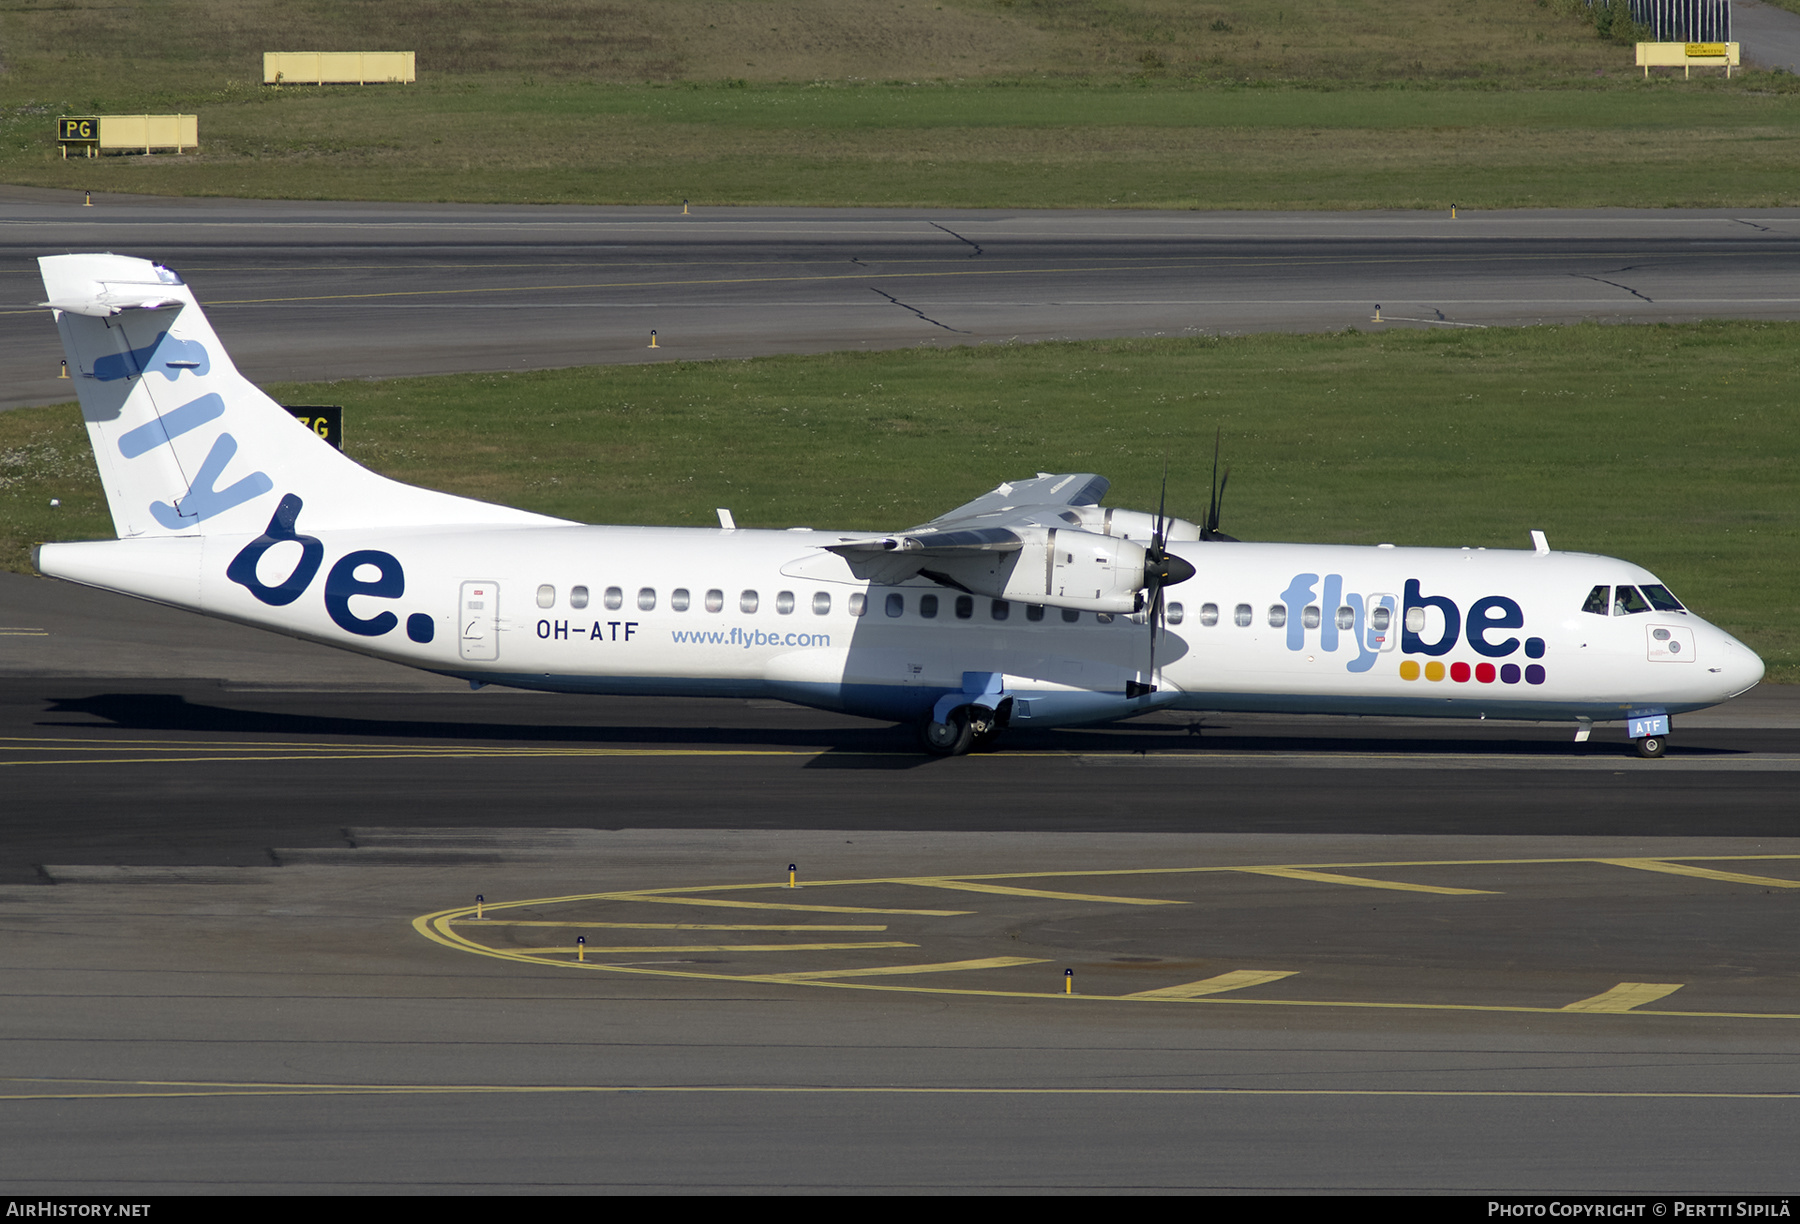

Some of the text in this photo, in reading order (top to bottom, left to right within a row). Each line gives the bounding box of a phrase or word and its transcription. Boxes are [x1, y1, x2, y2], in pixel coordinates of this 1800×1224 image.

[66, 121, 91, 137] PG
[536, 619, 639, 642] OH-ATF
[1279, 573, 1546, 673] flybe.
[672, 627, 831, 649] www.flybe.com
[1636, 720, 1661, 734] ATF
